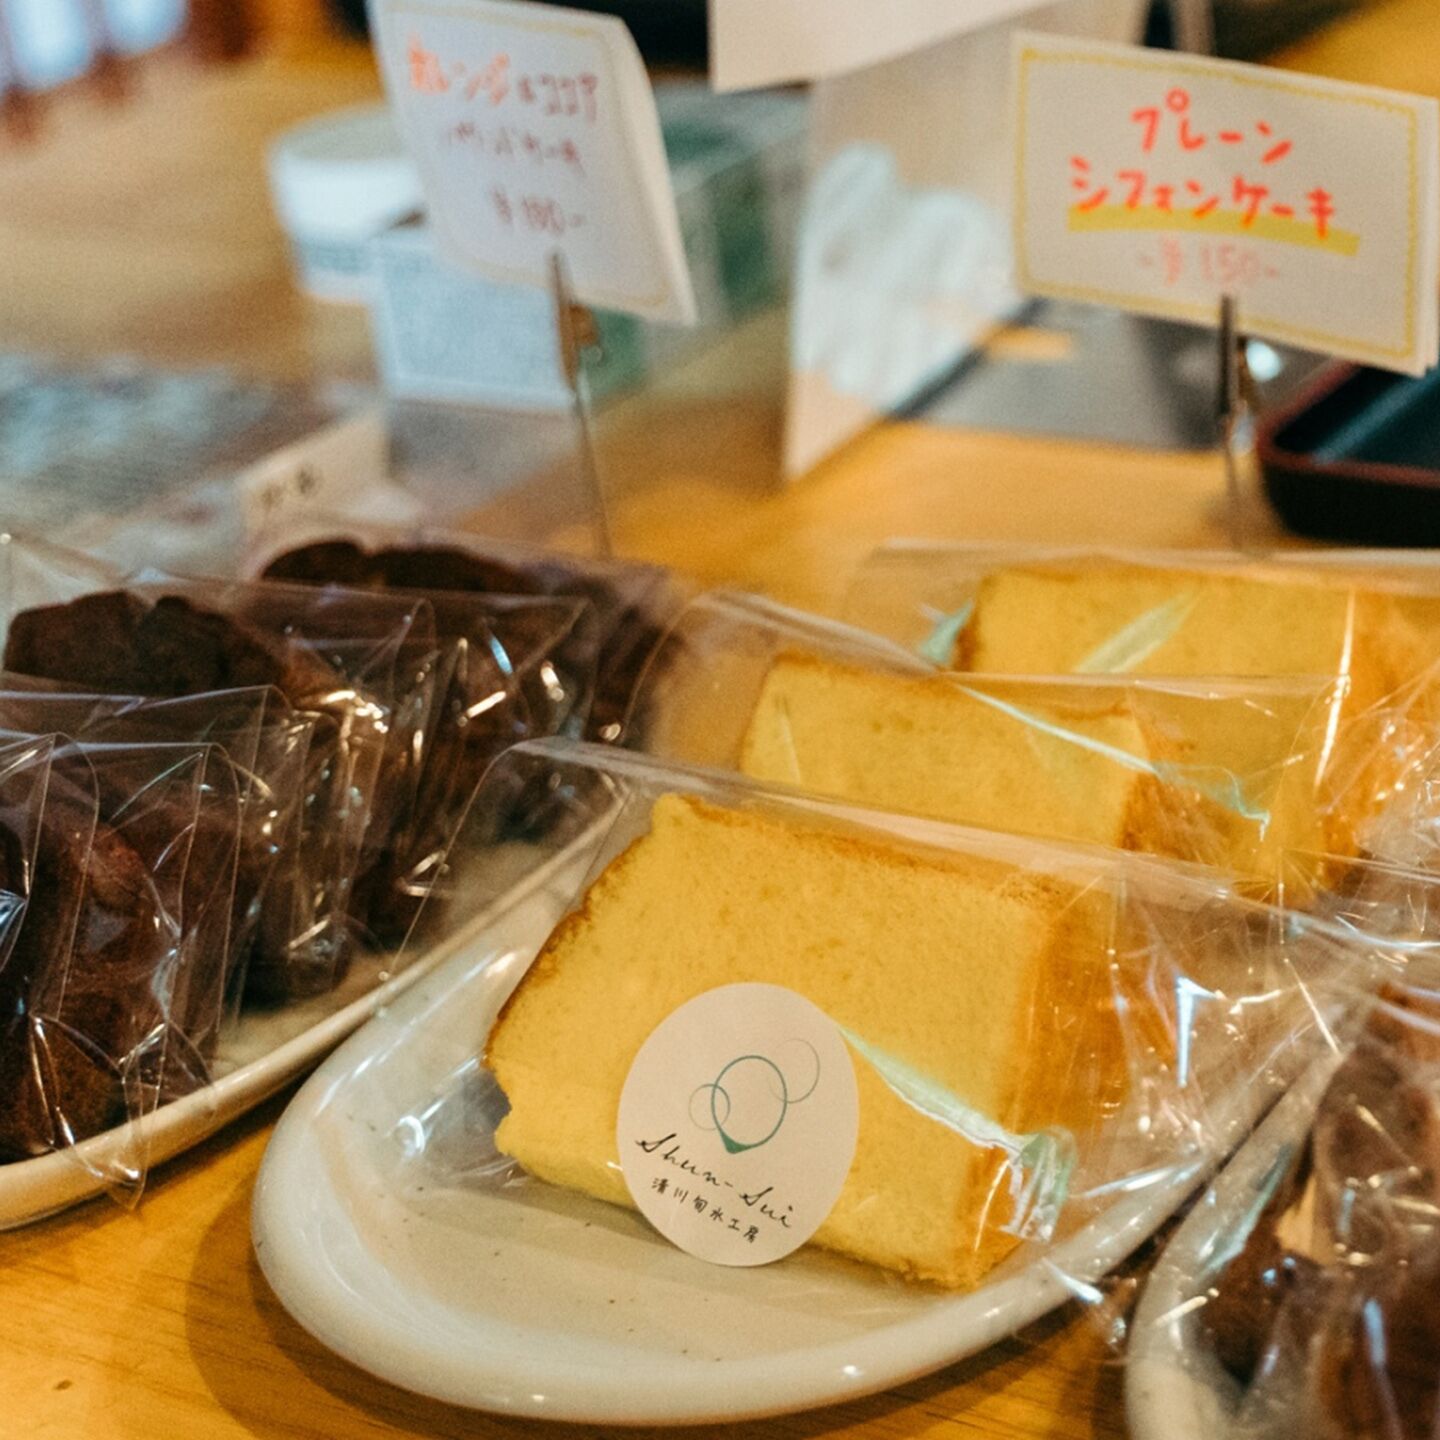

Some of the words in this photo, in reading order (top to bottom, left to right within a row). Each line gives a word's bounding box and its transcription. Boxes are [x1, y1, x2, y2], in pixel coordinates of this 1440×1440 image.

[1130, 87, 1294, 166] プレーン
[635, 1132, 792, 1228] Shun-Sui
